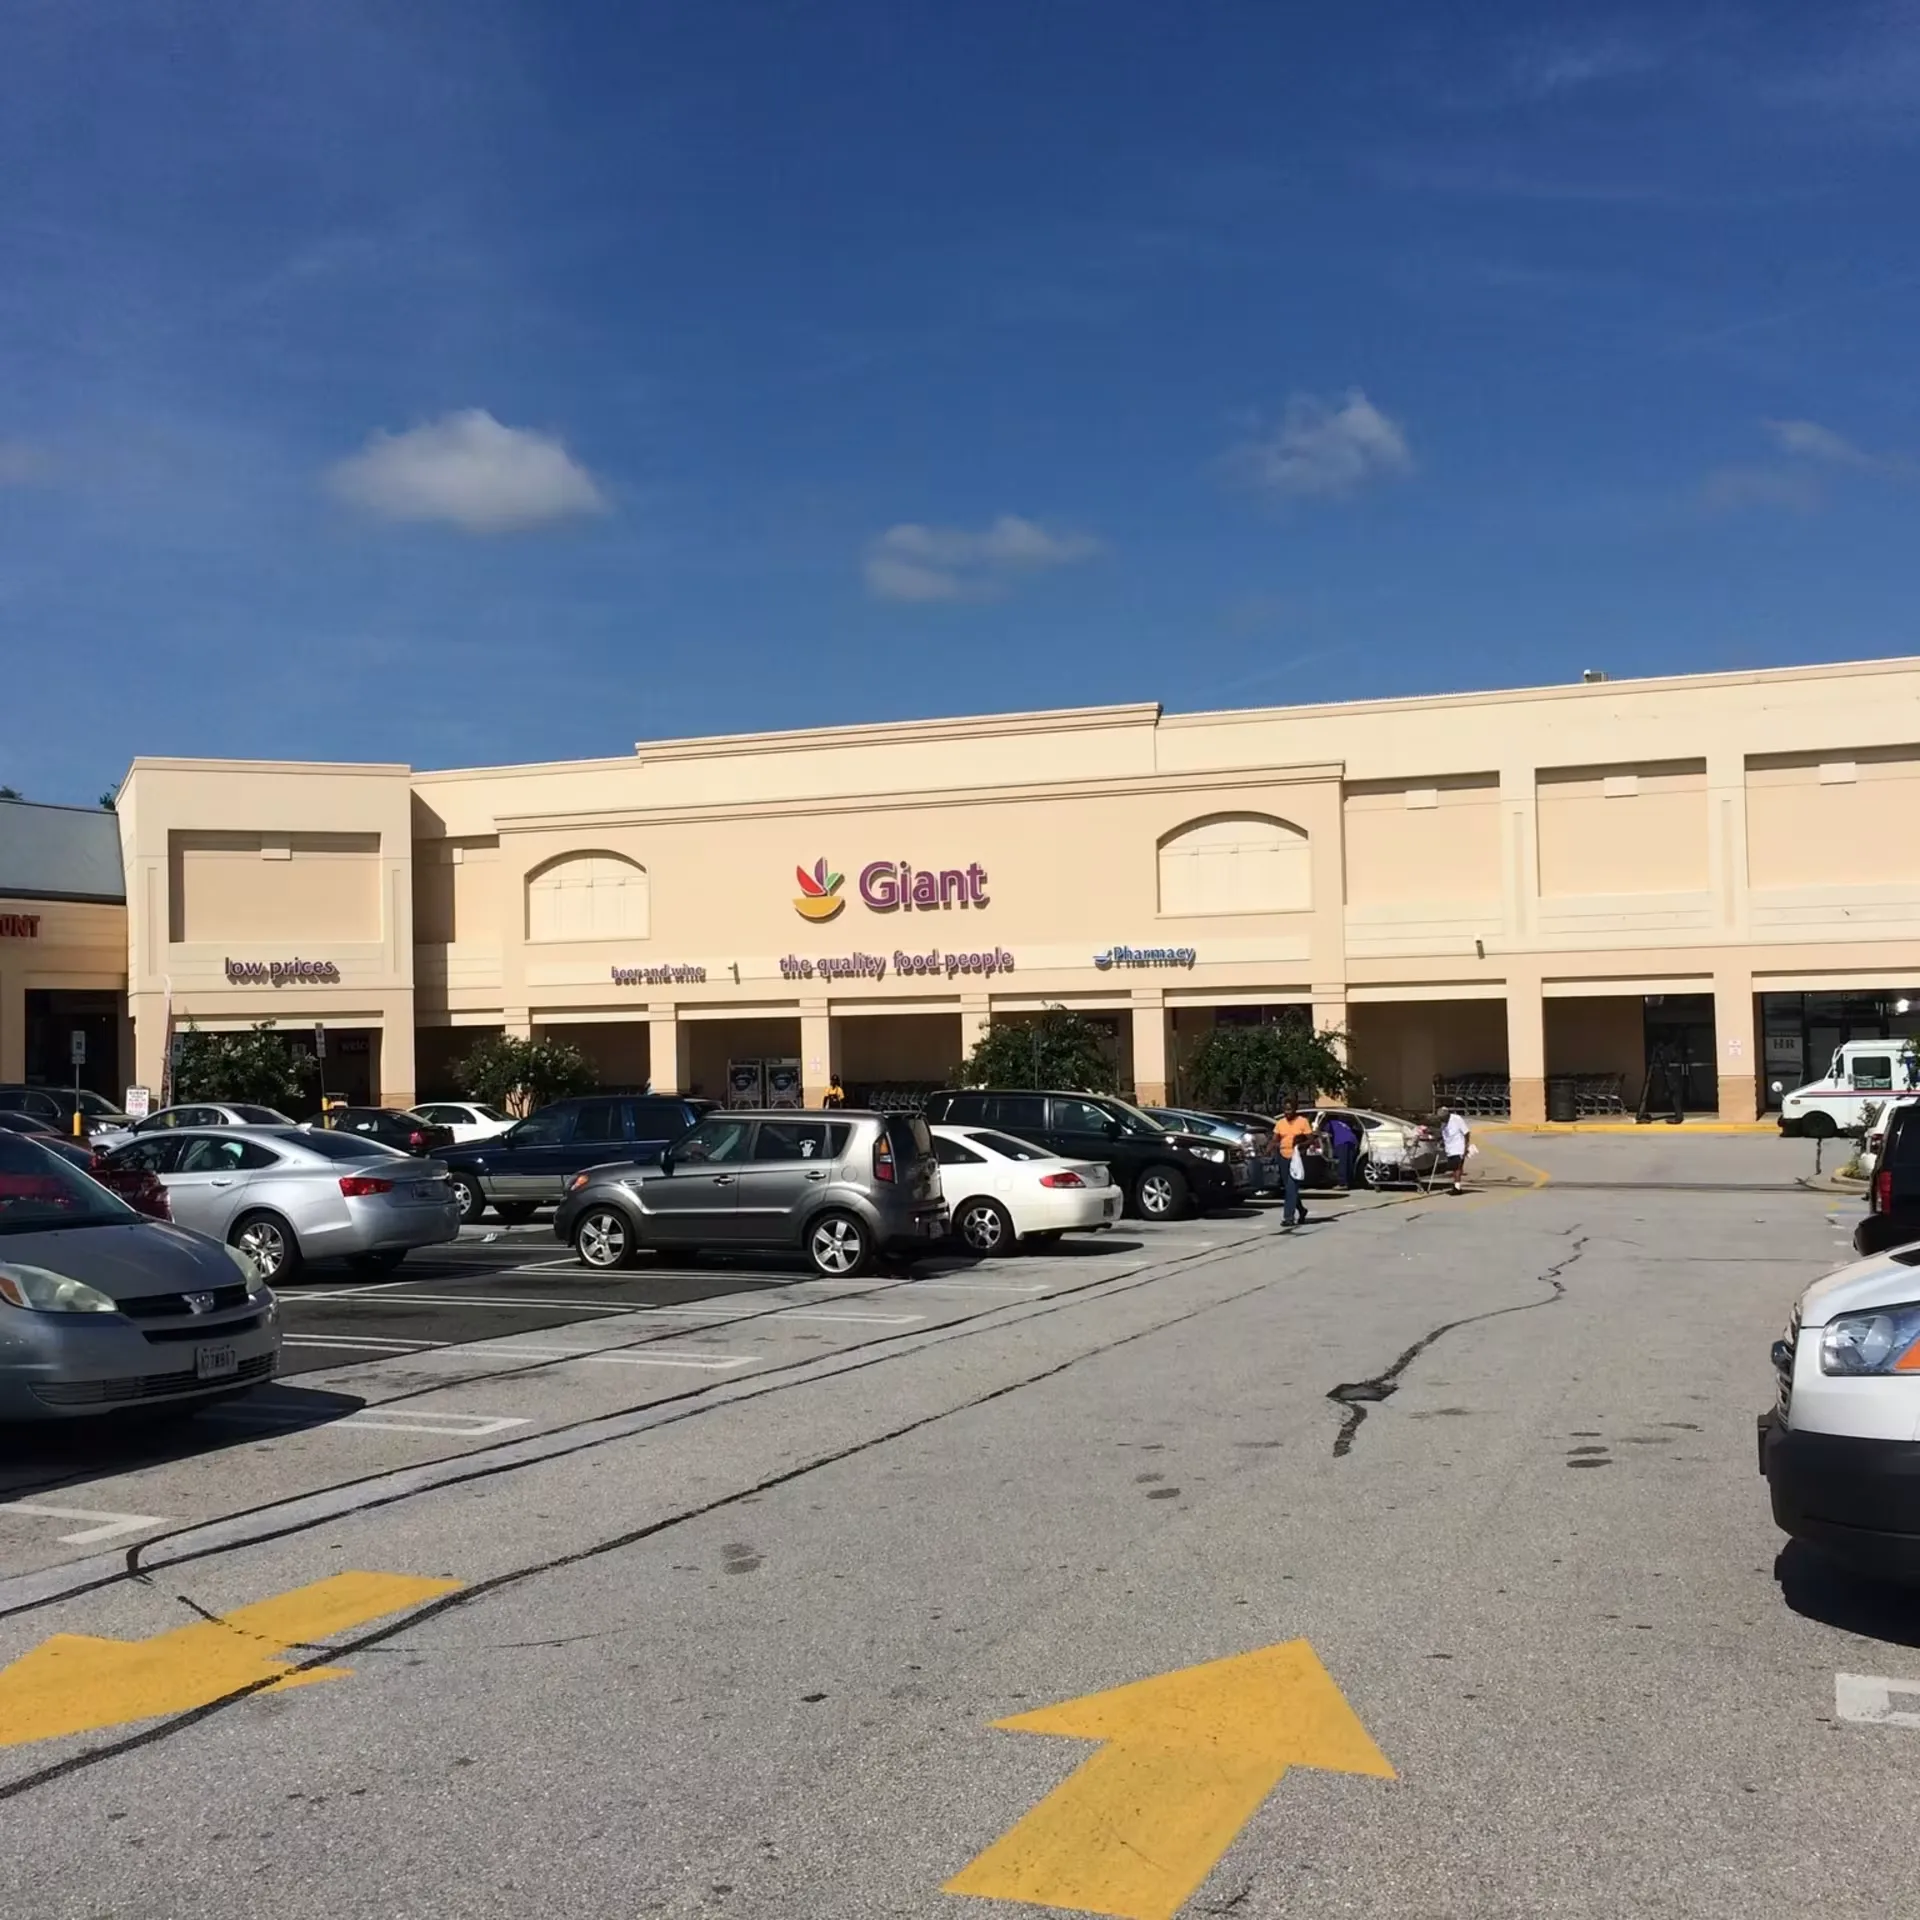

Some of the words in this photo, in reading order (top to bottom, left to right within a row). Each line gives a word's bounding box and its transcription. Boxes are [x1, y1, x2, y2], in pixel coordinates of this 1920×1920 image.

[859, 861, 985, 907] Giant
[780, 954, 811, 972] the
[817, 952, 884, 978] quality
[893, 949, 939, 969] food
[945, 947, 1012, 974] people
[1114, 946, 1195, 967] Pharmacy
[225, 957, 263, 976] low
[270, 957, 335, 980] prices
[611, 965, 642, 979] beer
[643, 964, 668, 978] and
[670, 963, 705, 977] wine
